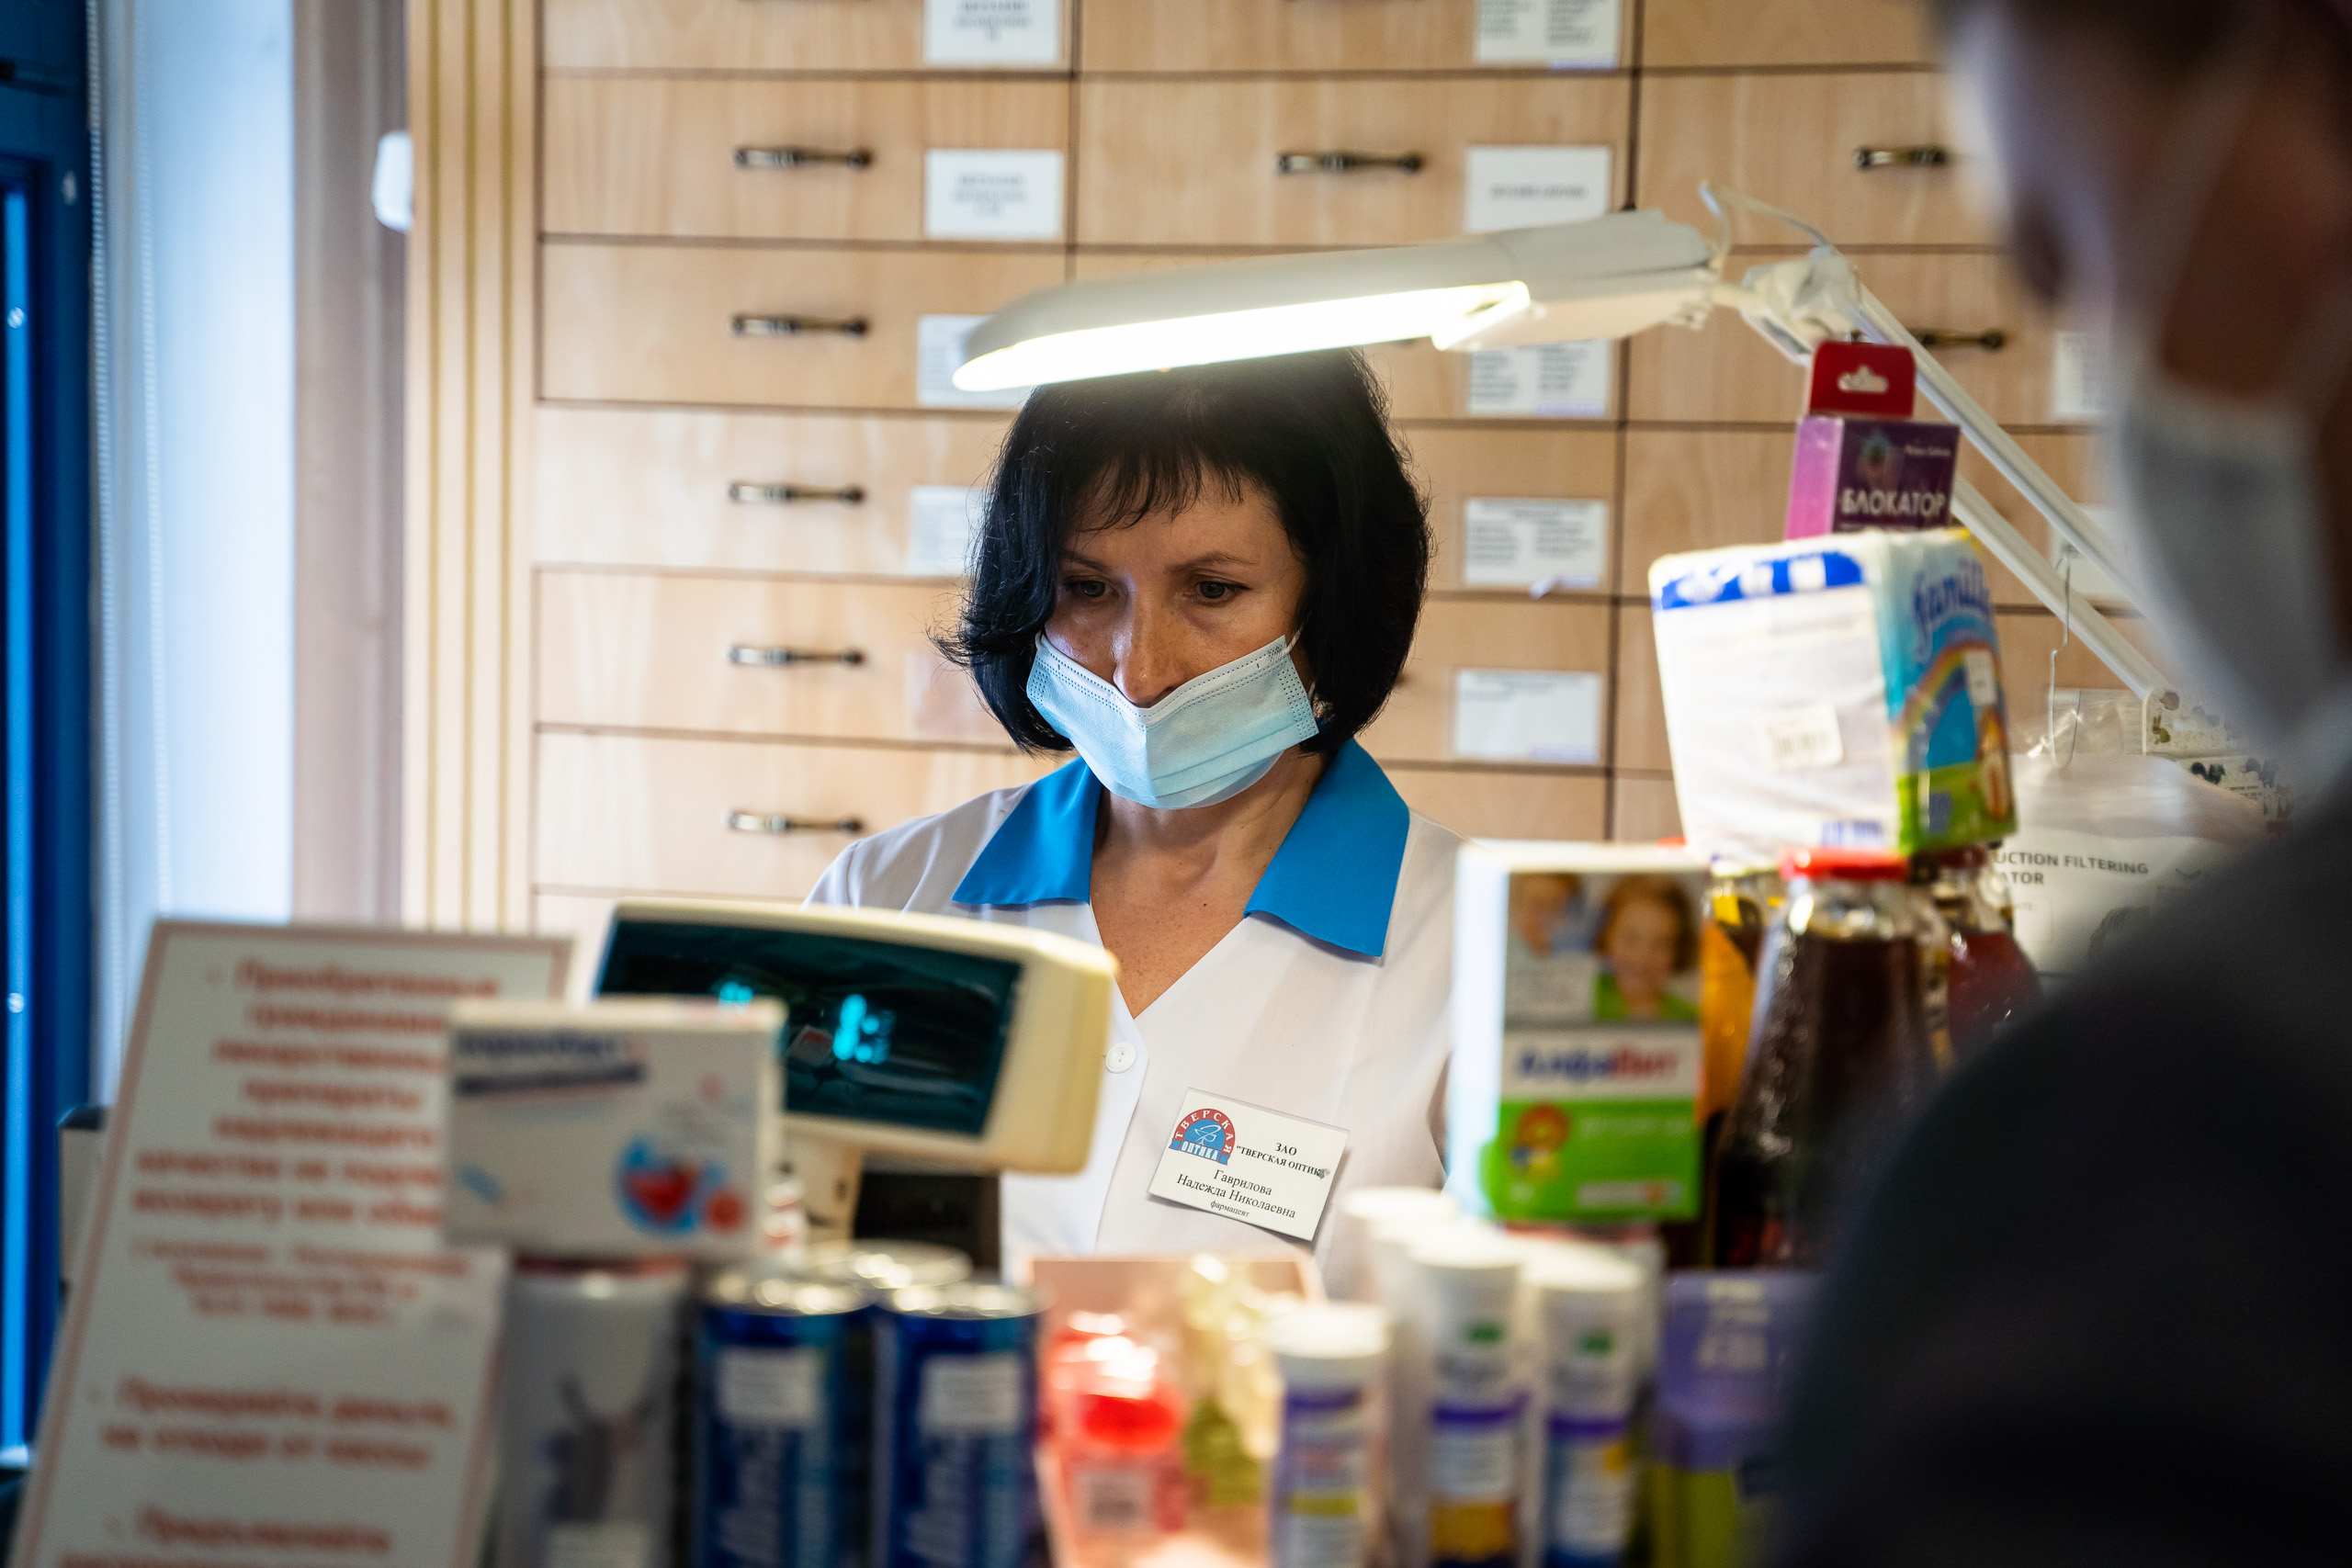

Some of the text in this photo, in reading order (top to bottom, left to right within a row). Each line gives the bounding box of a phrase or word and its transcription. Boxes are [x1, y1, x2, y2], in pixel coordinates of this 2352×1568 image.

[1841, 487, 1947, 517] БЛОКАТОР
[2064, 854, 2149, 874] FILTERING
[1175, 1110, 1234, 1154] ТВЕРСКАЯ
[1181, 1141, 1219, 1161] ОПТИКА
[1275, 1142, 1297, 1156] ЗАО
[1288, 1160, 1324, 1179] ОПТИК
[1213, 1169, 1272, 1196] Гаврилова
[1177, 1173, 1295, 1219] Надежда Николаевна
[1210, 1200, 1250, 1218] фармацевт
